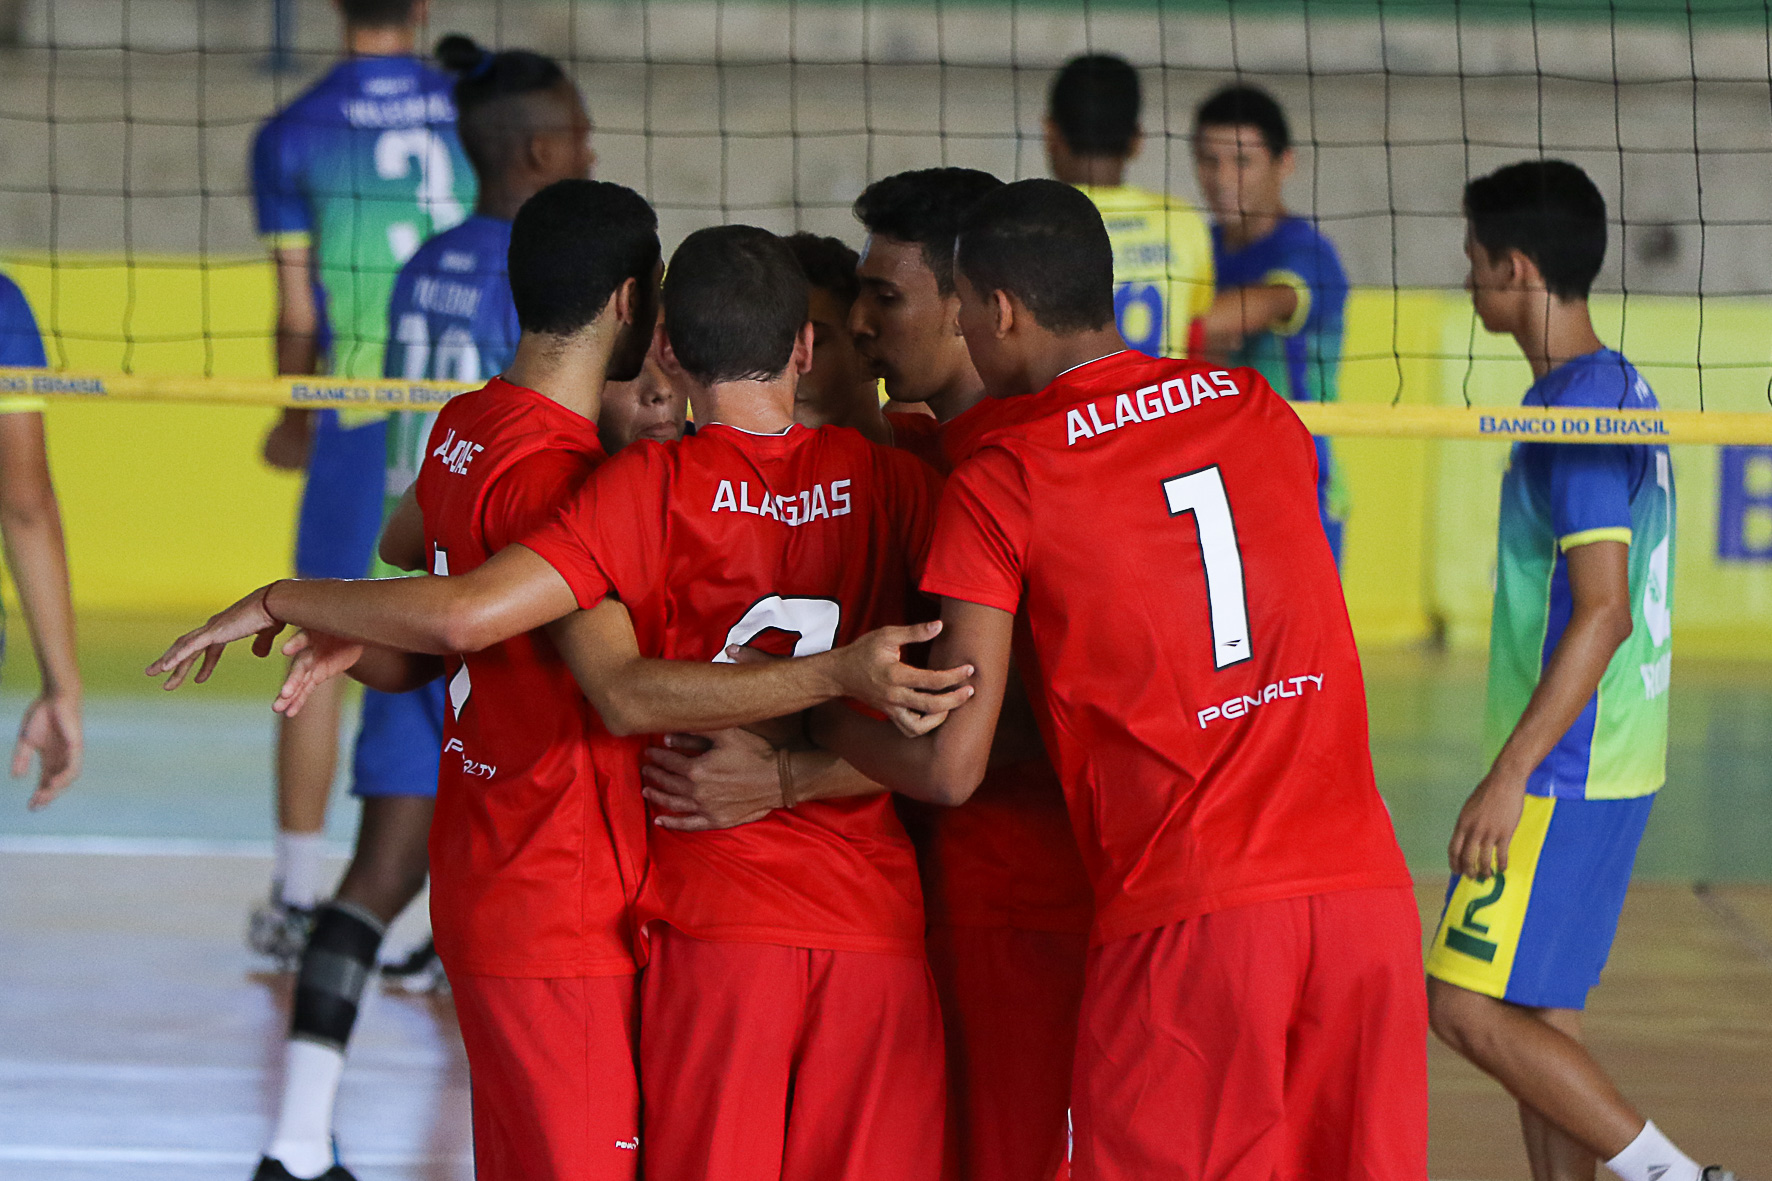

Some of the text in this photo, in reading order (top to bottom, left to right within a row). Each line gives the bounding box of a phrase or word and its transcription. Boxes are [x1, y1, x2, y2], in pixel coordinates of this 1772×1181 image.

[1066, 370, 1241, 446] ALAGOAS
[1479, 415, 1670, 437] BANCO DO BRASIL
[711, 478, 852, 527] ALAGOAS
[1162, 463, 1254, 671] 1
[1197, 673, 1325, 729] PENALTY
